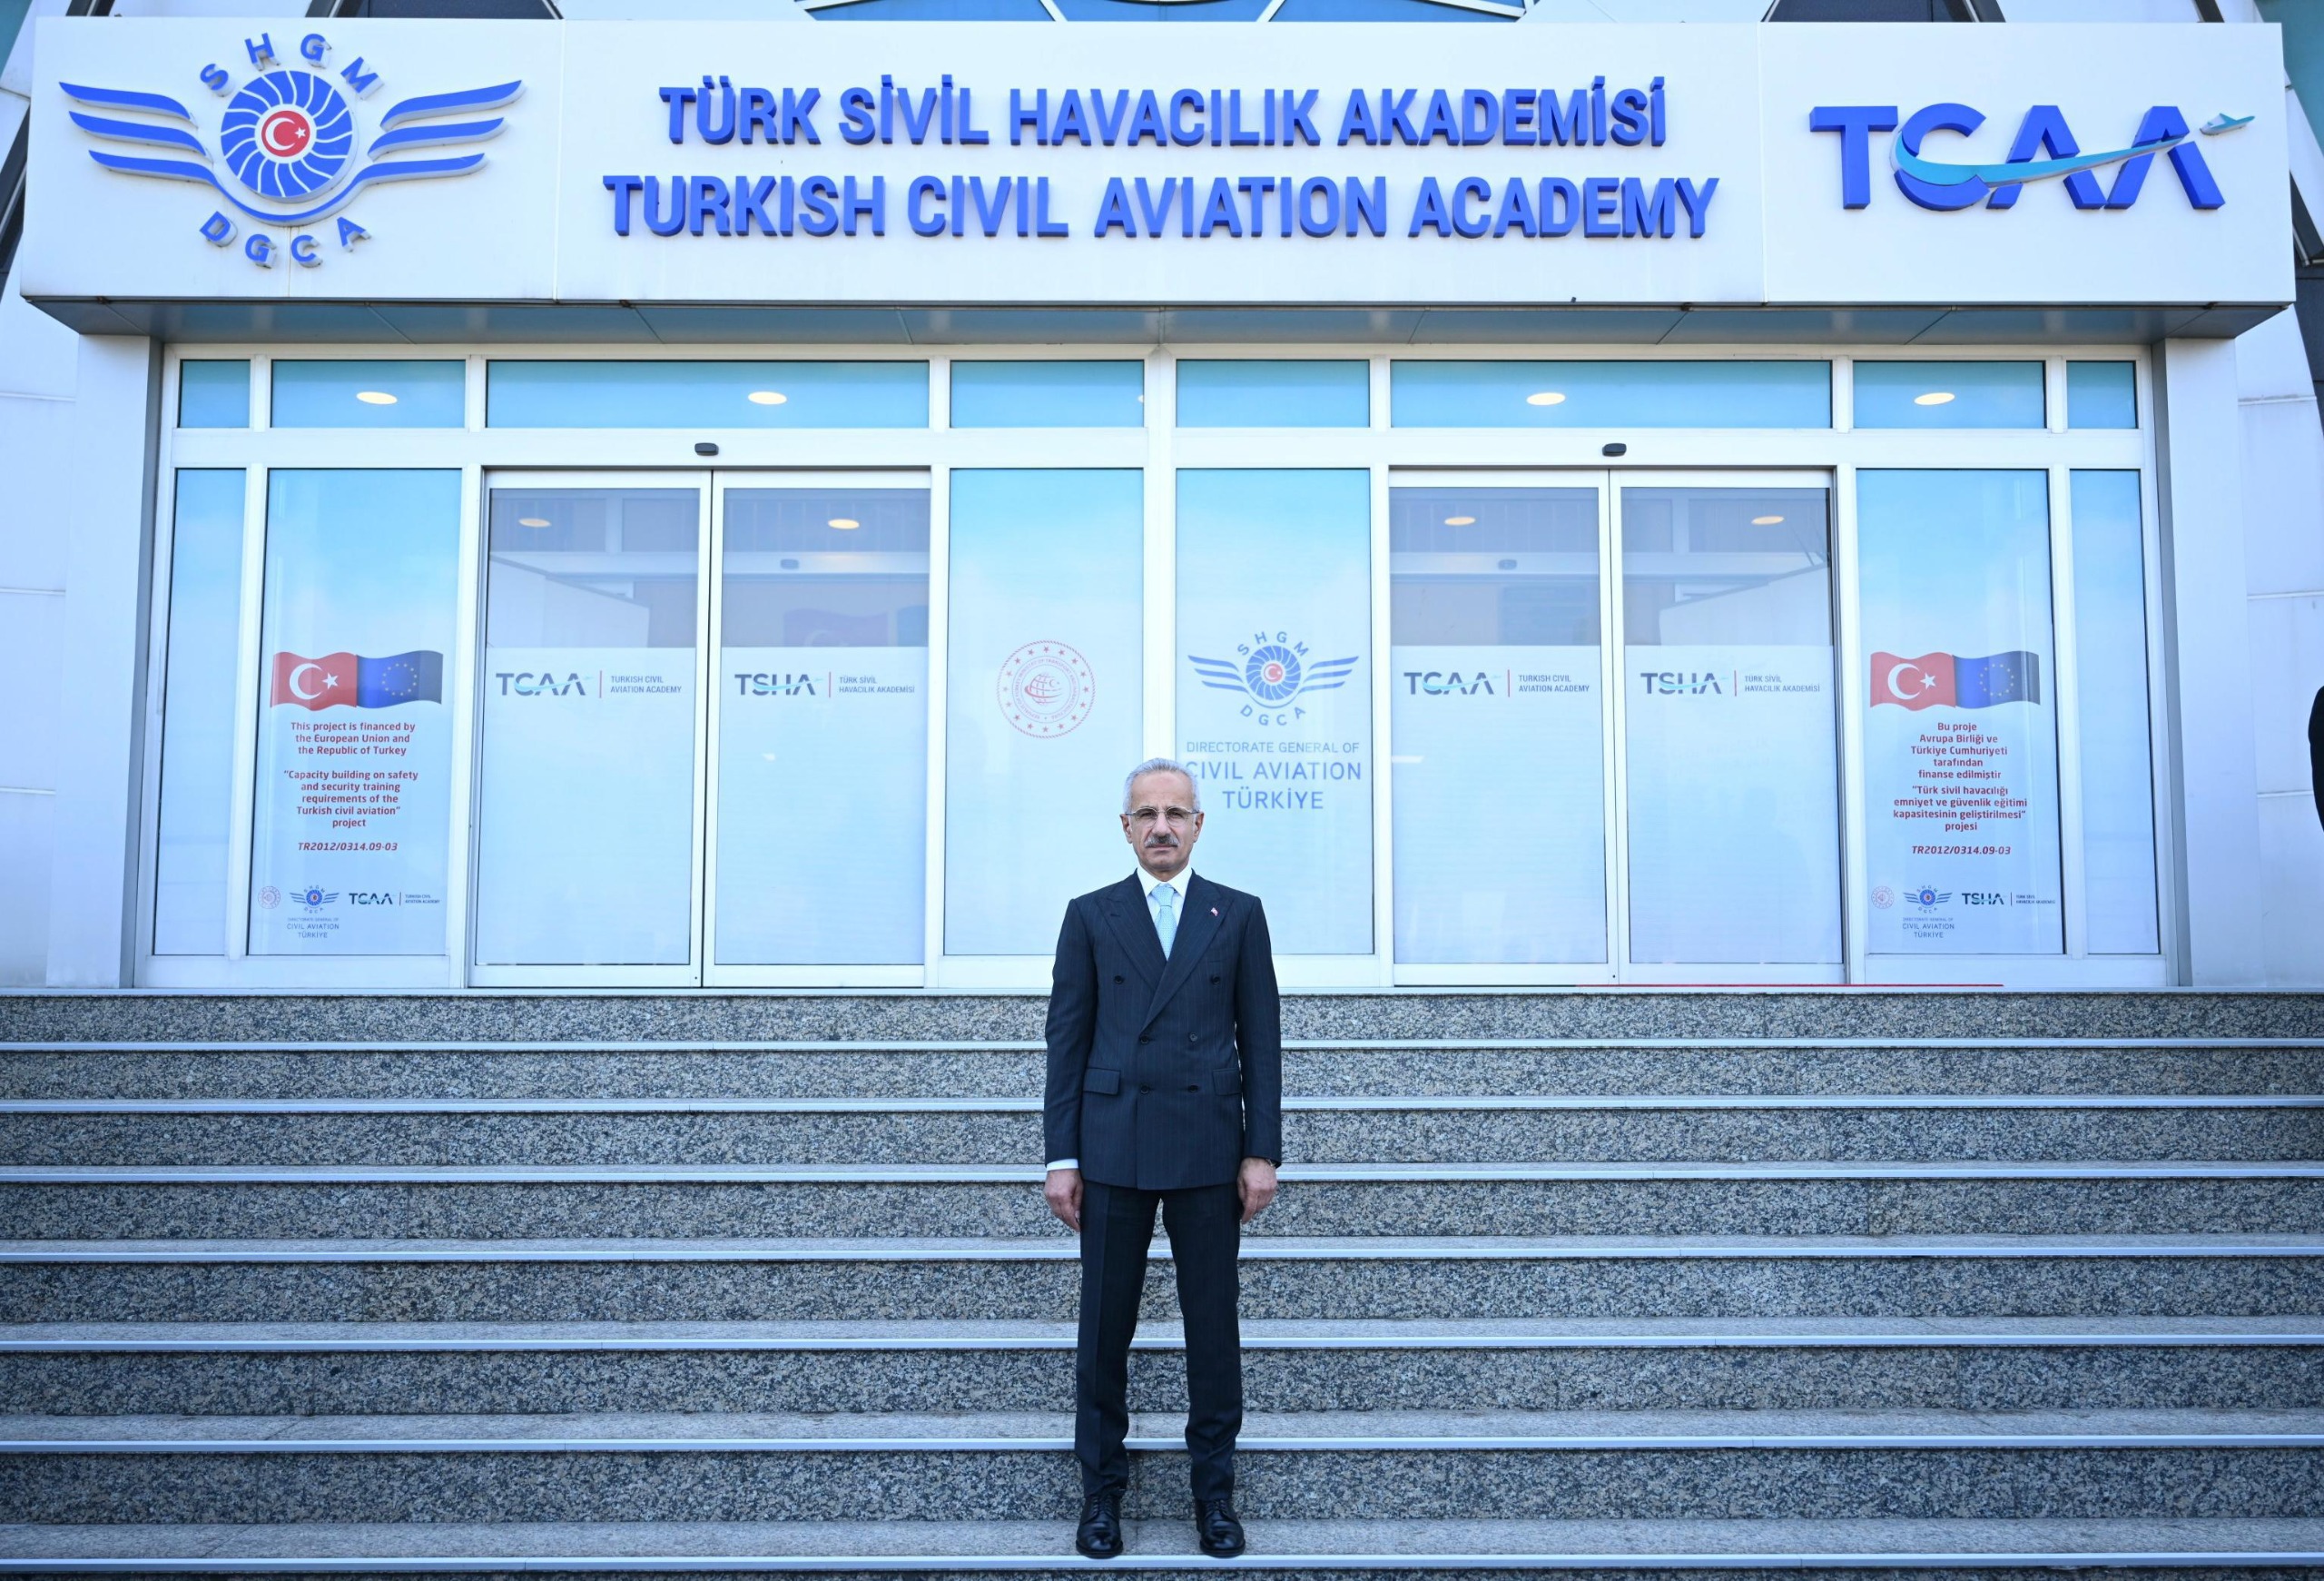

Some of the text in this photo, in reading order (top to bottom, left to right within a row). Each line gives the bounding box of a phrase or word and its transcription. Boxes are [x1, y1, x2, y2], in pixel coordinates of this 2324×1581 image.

[200, 33, 384, 99] SHGM
[659, 74, 1666, 147] TÜRK SİVİL HAVACILIK AKADEMİSİ
[1809, 103, 2226, 212] TCAA
[603, 175, 1719, 239] TURKISH CIVIL AVIATION ACADEMY
[200, 211, 371, 268] DGCA
[1237, 631, 1309, 657] SHGM
[840, 676, 877, 684] TÜRK SİVİL
[1403, 672, 1494, 695] TCAA
[1640, 672, 1721, 695] TSHA
[1765, 675, 1781, 683] SİVİL
[496, 673, 586, 696] TCAA
[734, 673, 815, 696] TSHA
[1240, 705, 1305, 726] DGCA
[291, 722, 415, 733] This project is financed by
[1953, 723, 1976, 732] proje
[314, 734, 359, 744] European
[393, 735, 409, 743] and
[1920, 735, 1953, 744] Avrupa
[1956, 735, 1984, 745] Birliği
[317, 746, 358, 756] Republic
[373, 746, 407, 756] Turkey
[1187, 742, 1359, 753] DIRECTORATE GENERAL OF
[1911, 746, 2007, 756] Türkiye Cumhuriyeti
[1934, 758, 1983, 766] tarafından
[332, 770, 370, 780] building
[388, 771, 418, 781] safety
[1254, 762, 1362, 780] AVIATION
[1918, 770, 2001, 780] finanse edilmiştir
[321, 783, 359, 793] security
[363, 783, 400, 793] training
[1942, 786, 1960, 794] sivil
[1964, 786, 2008, 796] havacılığı
[302, 795, 398, 804] requirements of the
[1222, 786, 1323, 809] TÜRKİYE
[1895, 797, 1933, 807] emniyet
[1950, 798, 1991, 808] güvenlik
[1994, 798, 2027, 808] eğitimi
[297, 806, 331, 815] Turkish
[335, 806, 354, 815] civil
[1894, 810, 1956, 819] kapasitesinin
[332, 818, 366, 828] project
[1945, 822, 1977, 832] projesi
[299, 843, 398, 851] TR2012/0314.09-03
[1912, 846, 2011, 855] TR2012/0314.09-03
[349, 893, 392, 904] TCAA
[1962, 894, 2004, 904] TSHA
